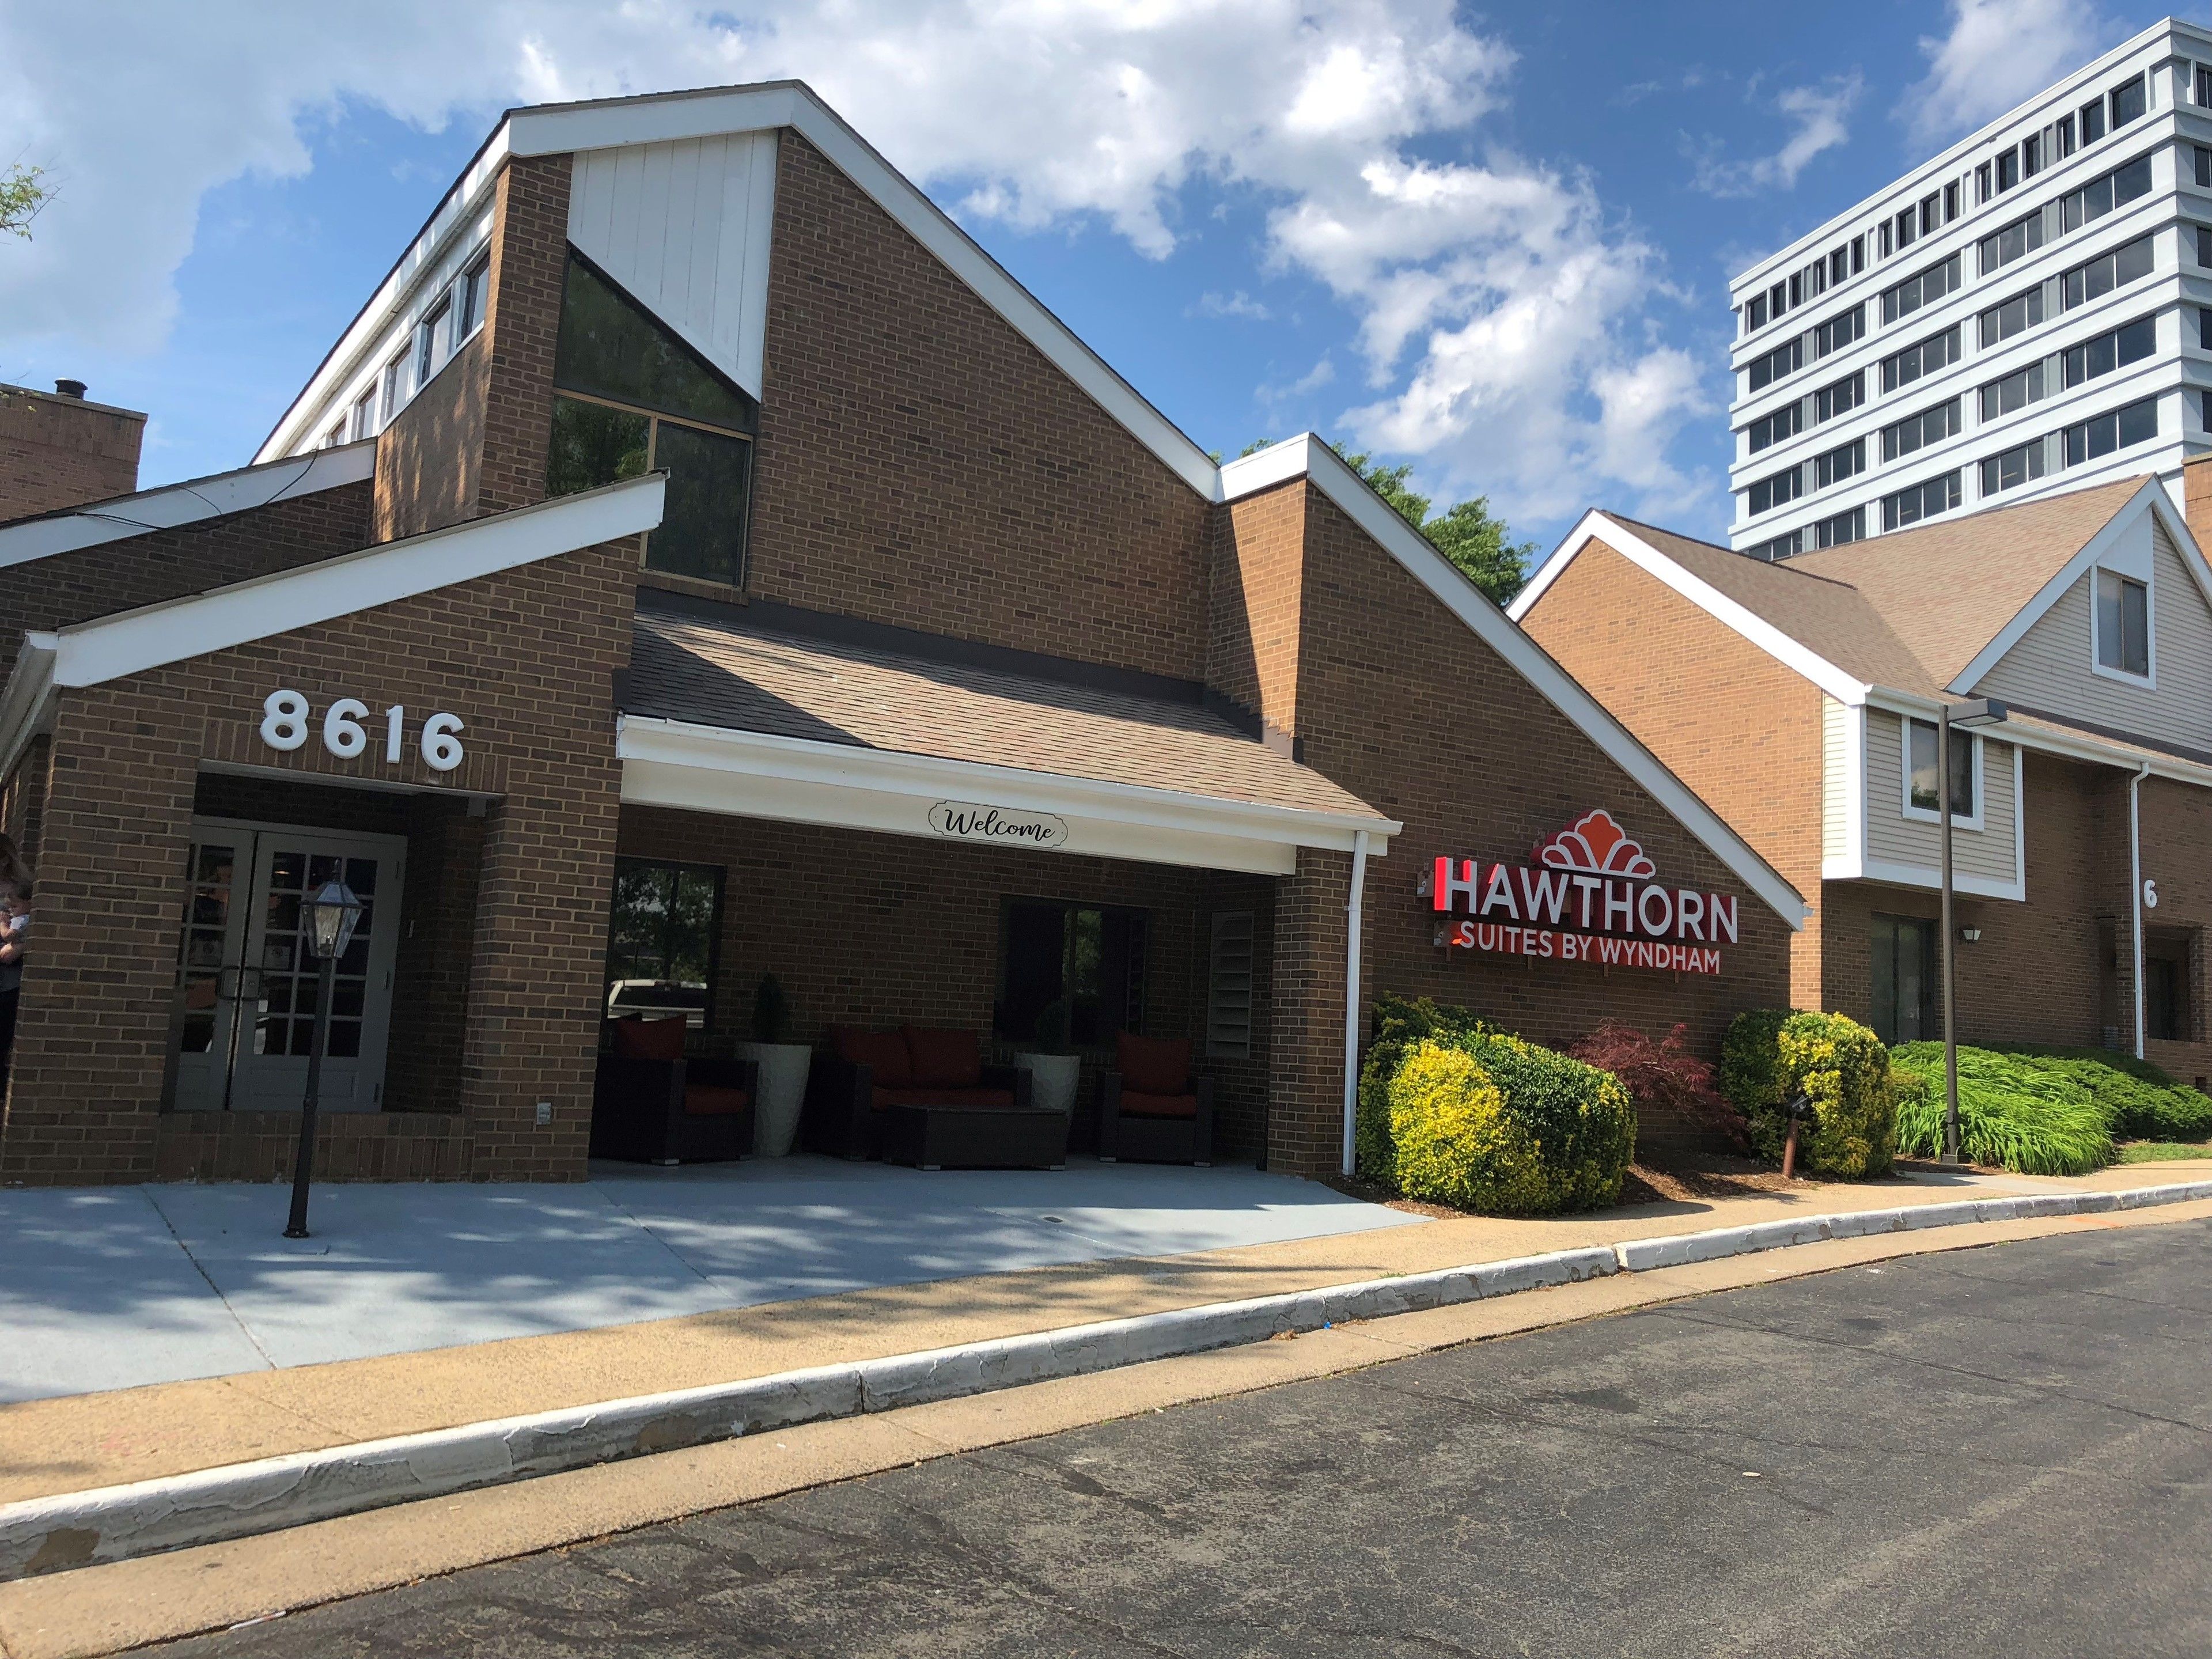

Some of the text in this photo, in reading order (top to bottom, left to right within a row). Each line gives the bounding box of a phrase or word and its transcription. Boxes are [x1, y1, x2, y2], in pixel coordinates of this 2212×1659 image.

[260, 690, 464, 771] 8616
[945, 810, 1055, 841] Welcome
[1435, 857, 1738, 943] HAWTHORN
[2144, 880, 2157, 908] 6
[1460, 921, 1719, 974] SUITES BY WYNDHAM
